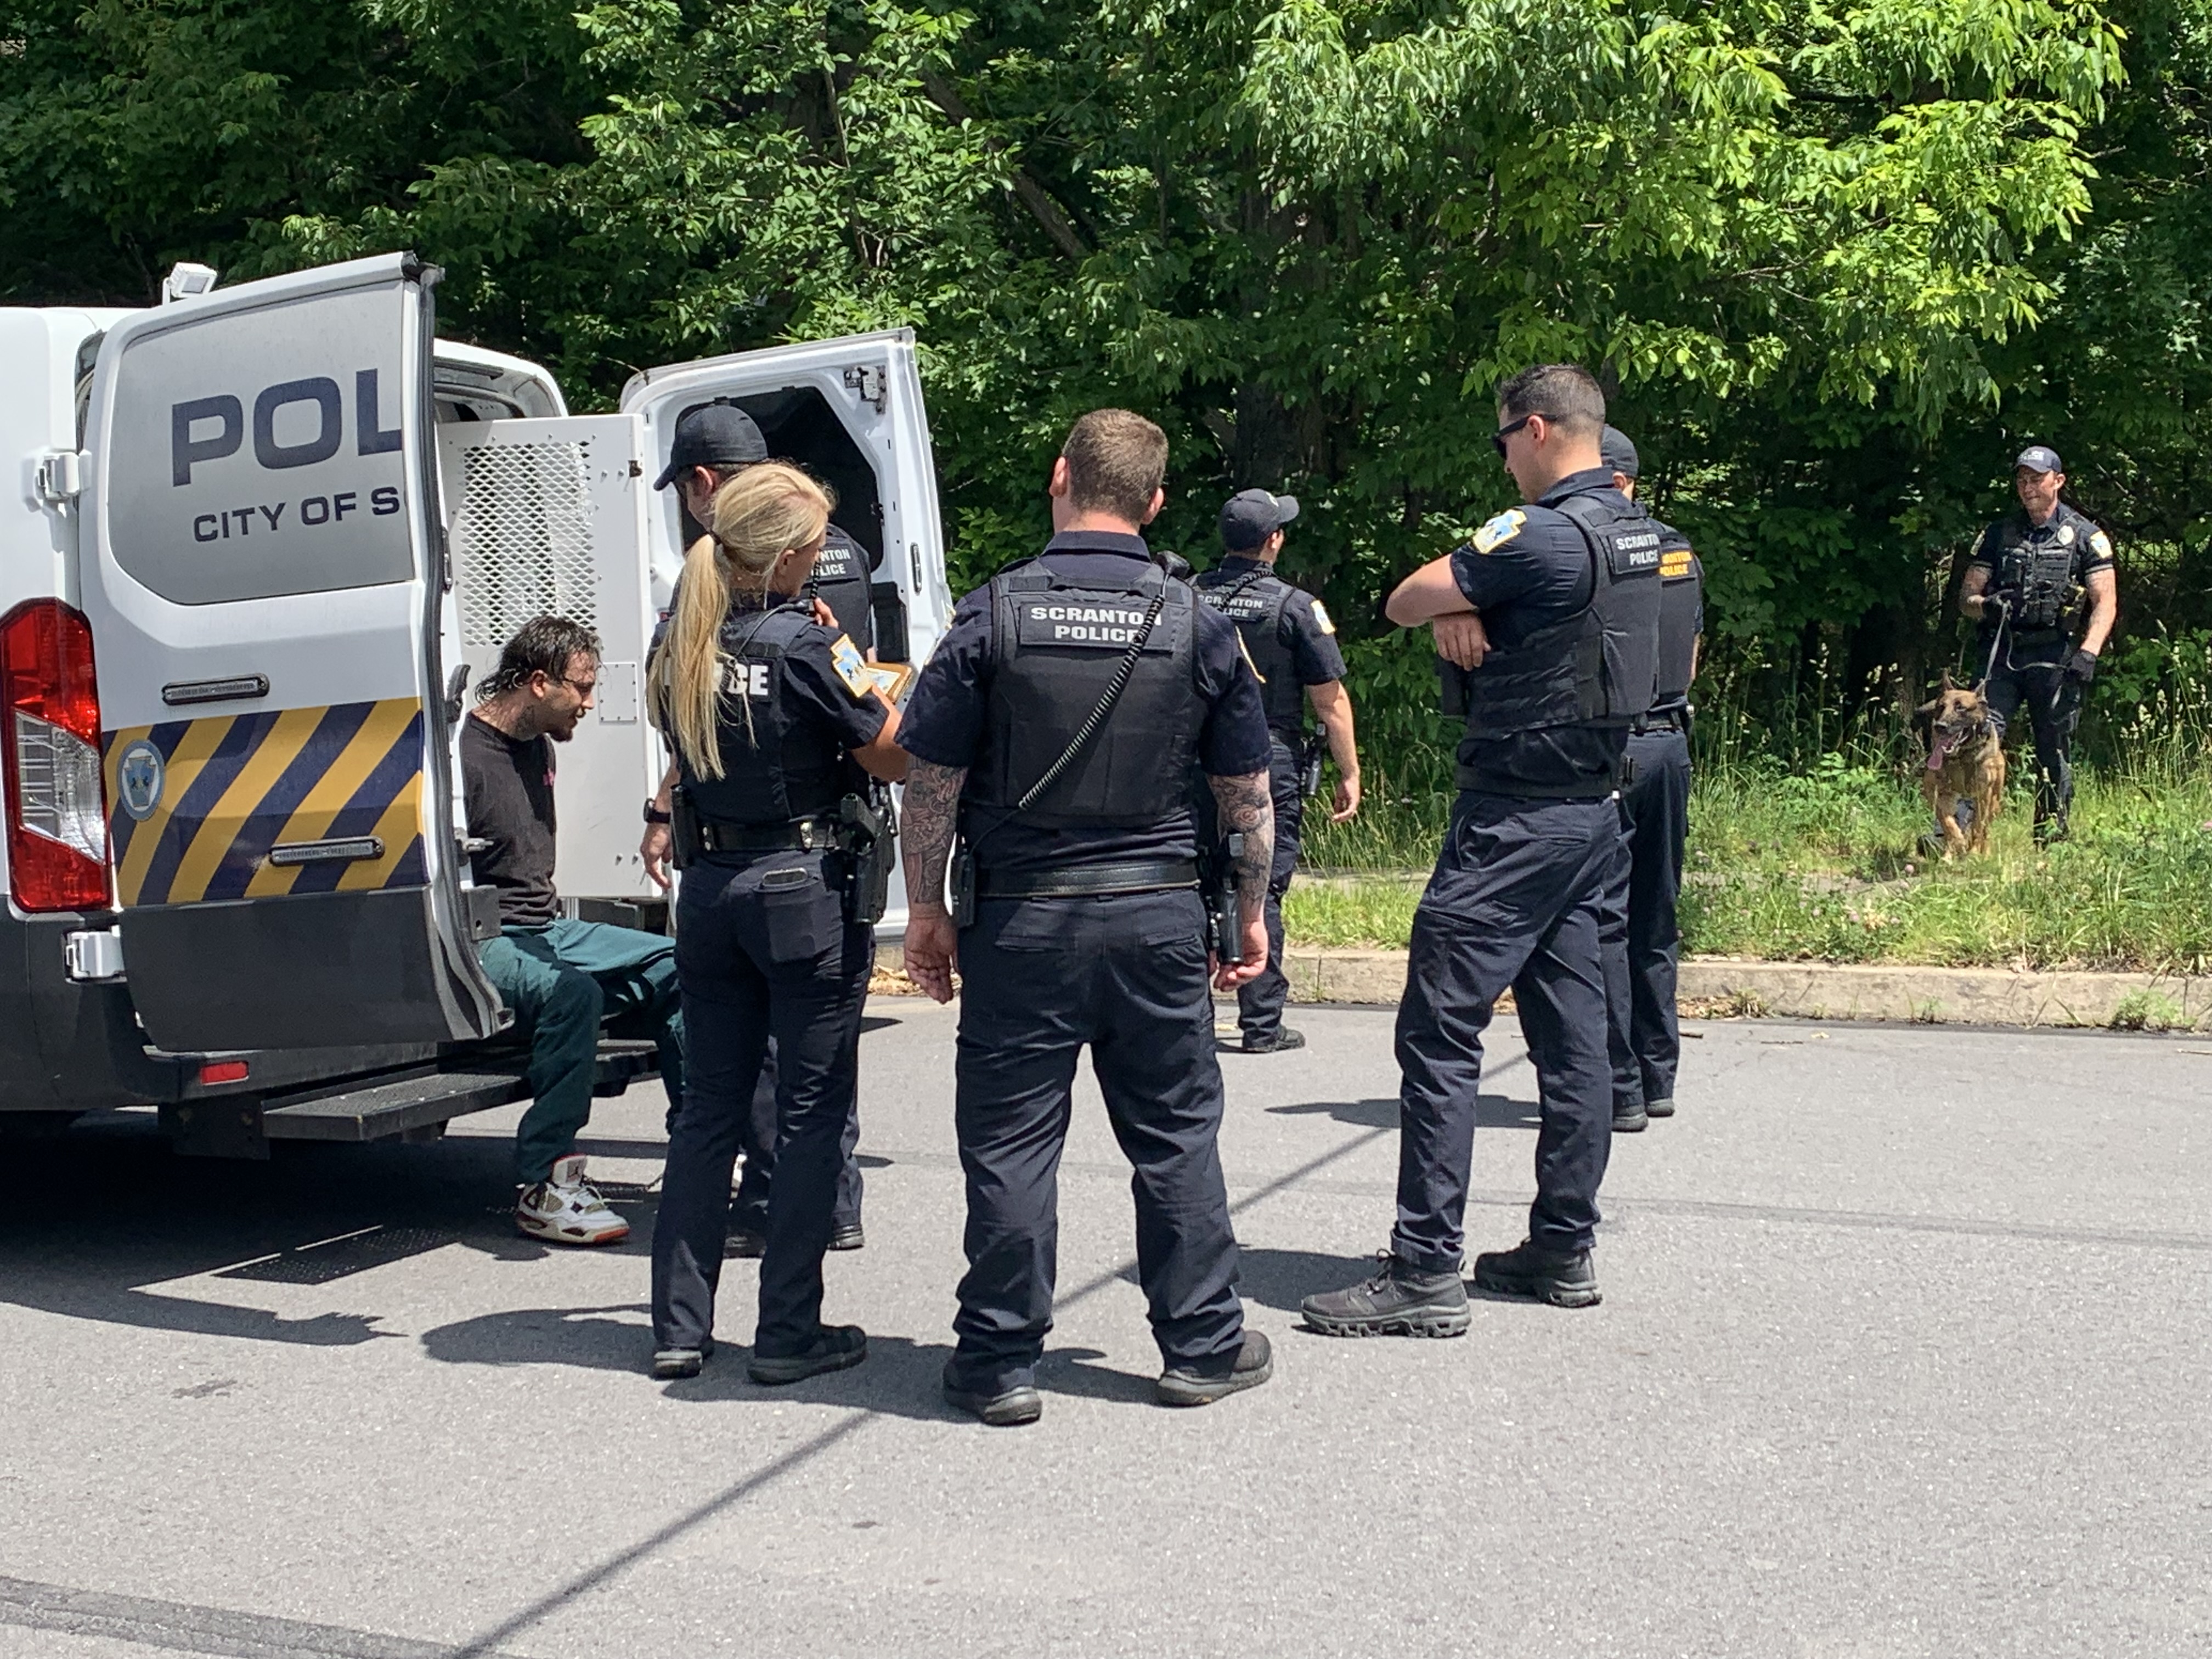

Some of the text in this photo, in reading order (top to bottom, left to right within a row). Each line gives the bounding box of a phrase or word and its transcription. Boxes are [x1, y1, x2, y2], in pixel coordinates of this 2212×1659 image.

[193, 501, 286, 543] CITY
[300, 492, 357, 526] OF
[820, 549, 851, 561] NTON
[1629, 550, 1659, 566] POLICE
[811, 563, 846, 576] LICE
[1223, 607, 1250, 617] LICE
